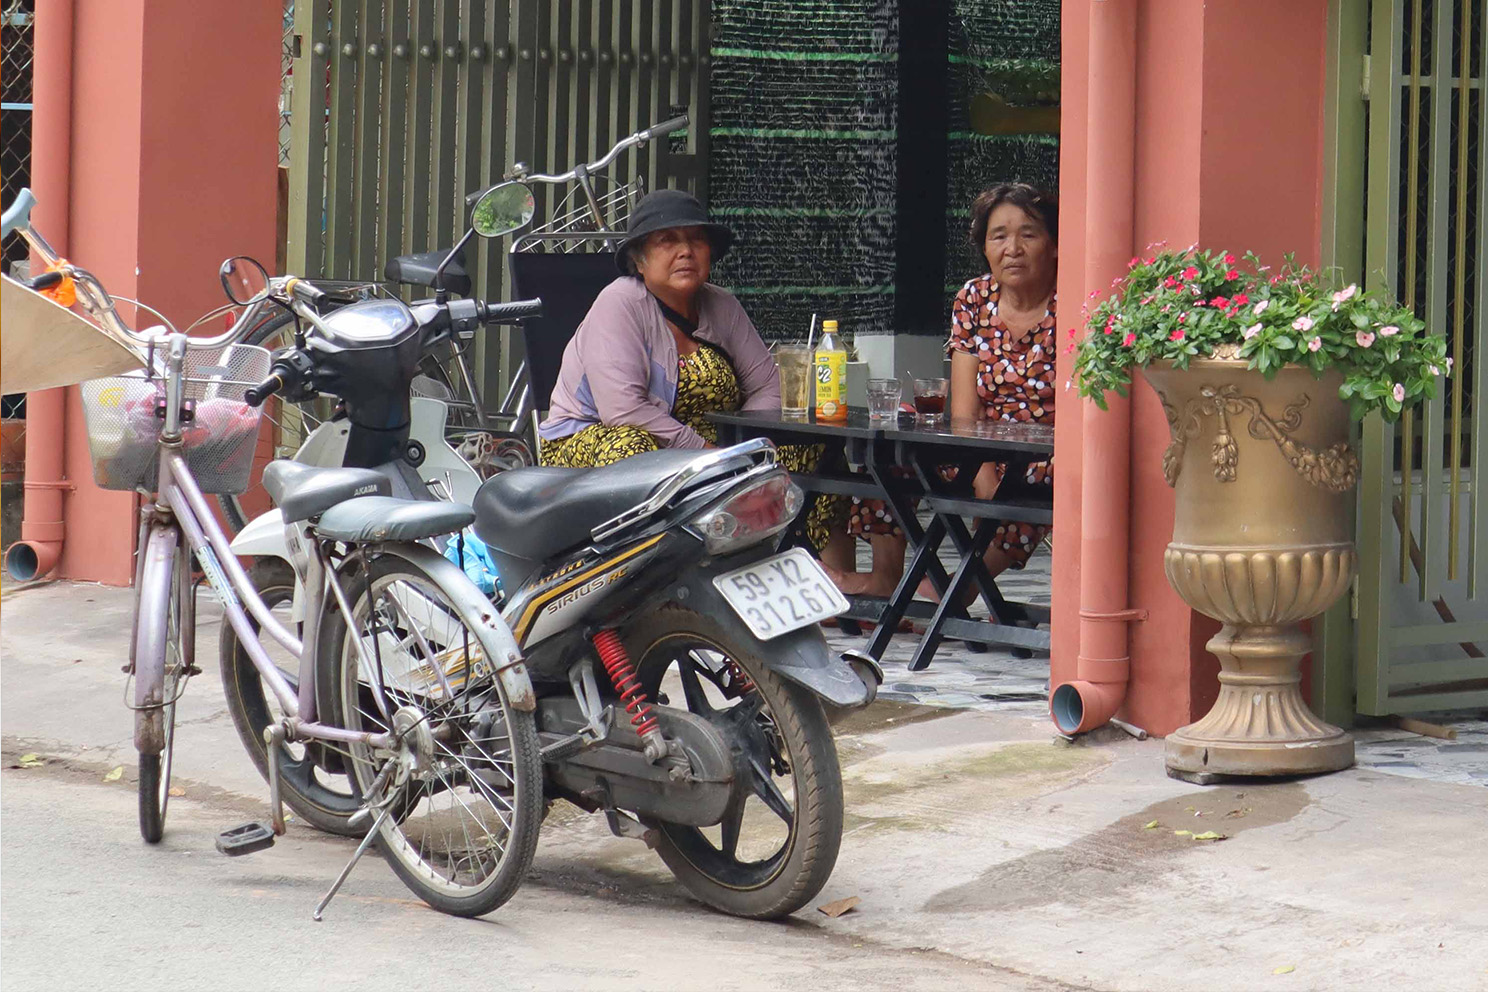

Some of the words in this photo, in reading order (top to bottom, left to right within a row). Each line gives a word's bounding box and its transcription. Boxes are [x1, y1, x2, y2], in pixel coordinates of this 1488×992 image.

[546, 576, 606, 615] SIRIUS
[607, 567, 629, 586] RC
[730, 557, 811, 602] 59-X2
[747, 583, 838, 632] 312.61
